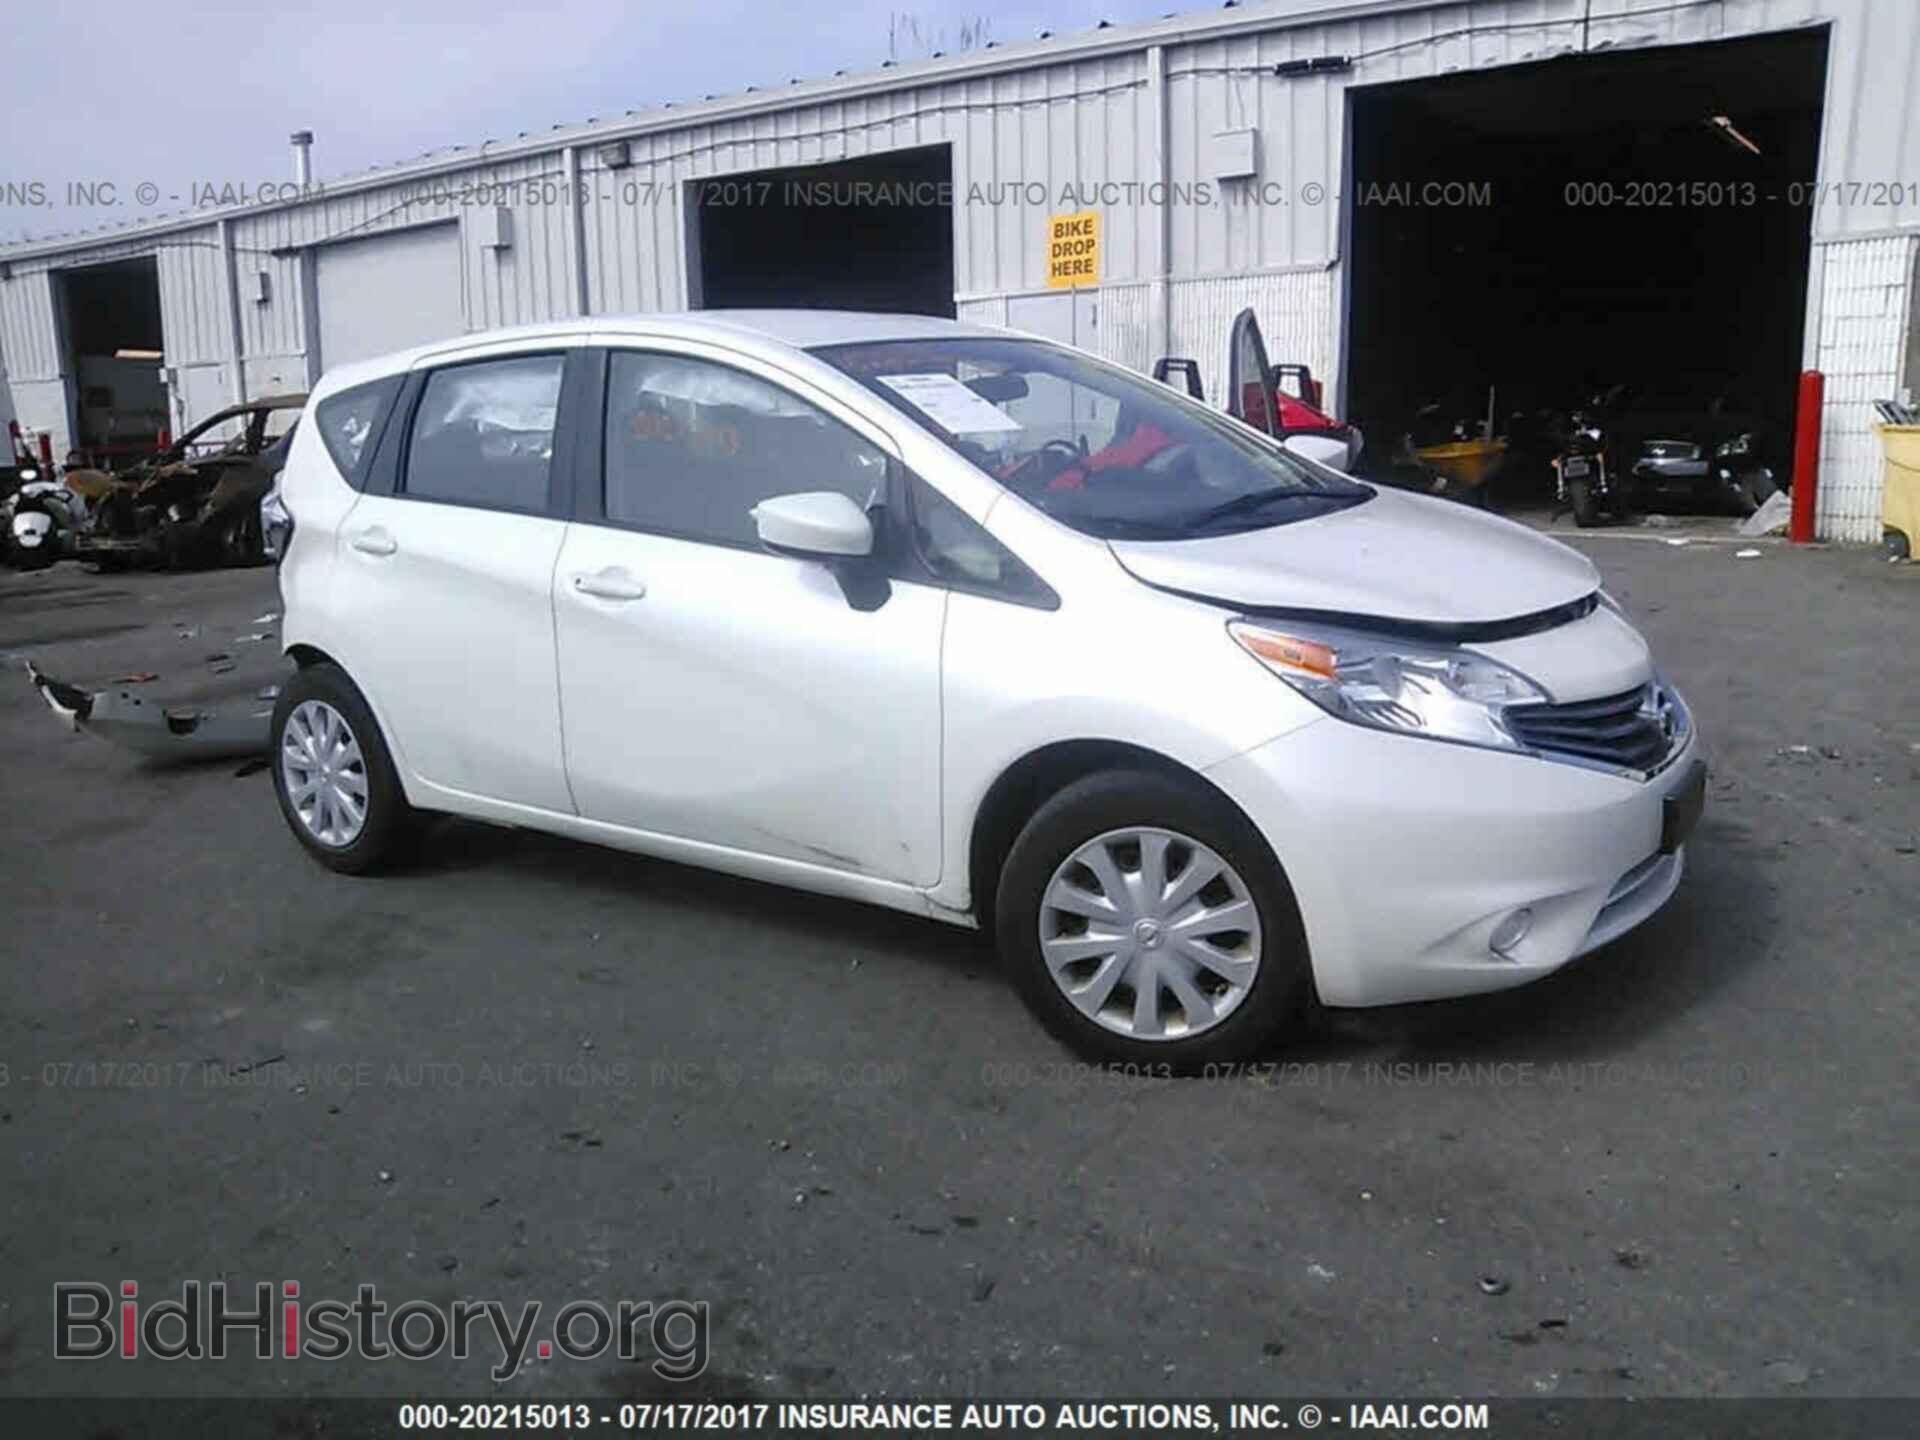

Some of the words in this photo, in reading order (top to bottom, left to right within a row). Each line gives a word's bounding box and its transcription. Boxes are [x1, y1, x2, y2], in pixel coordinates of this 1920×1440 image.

[1054, 218, 1094, 239] BIKE
[1052, 238, 1096, 258] DROP
[1051, 258, 1094, 277] HERE
